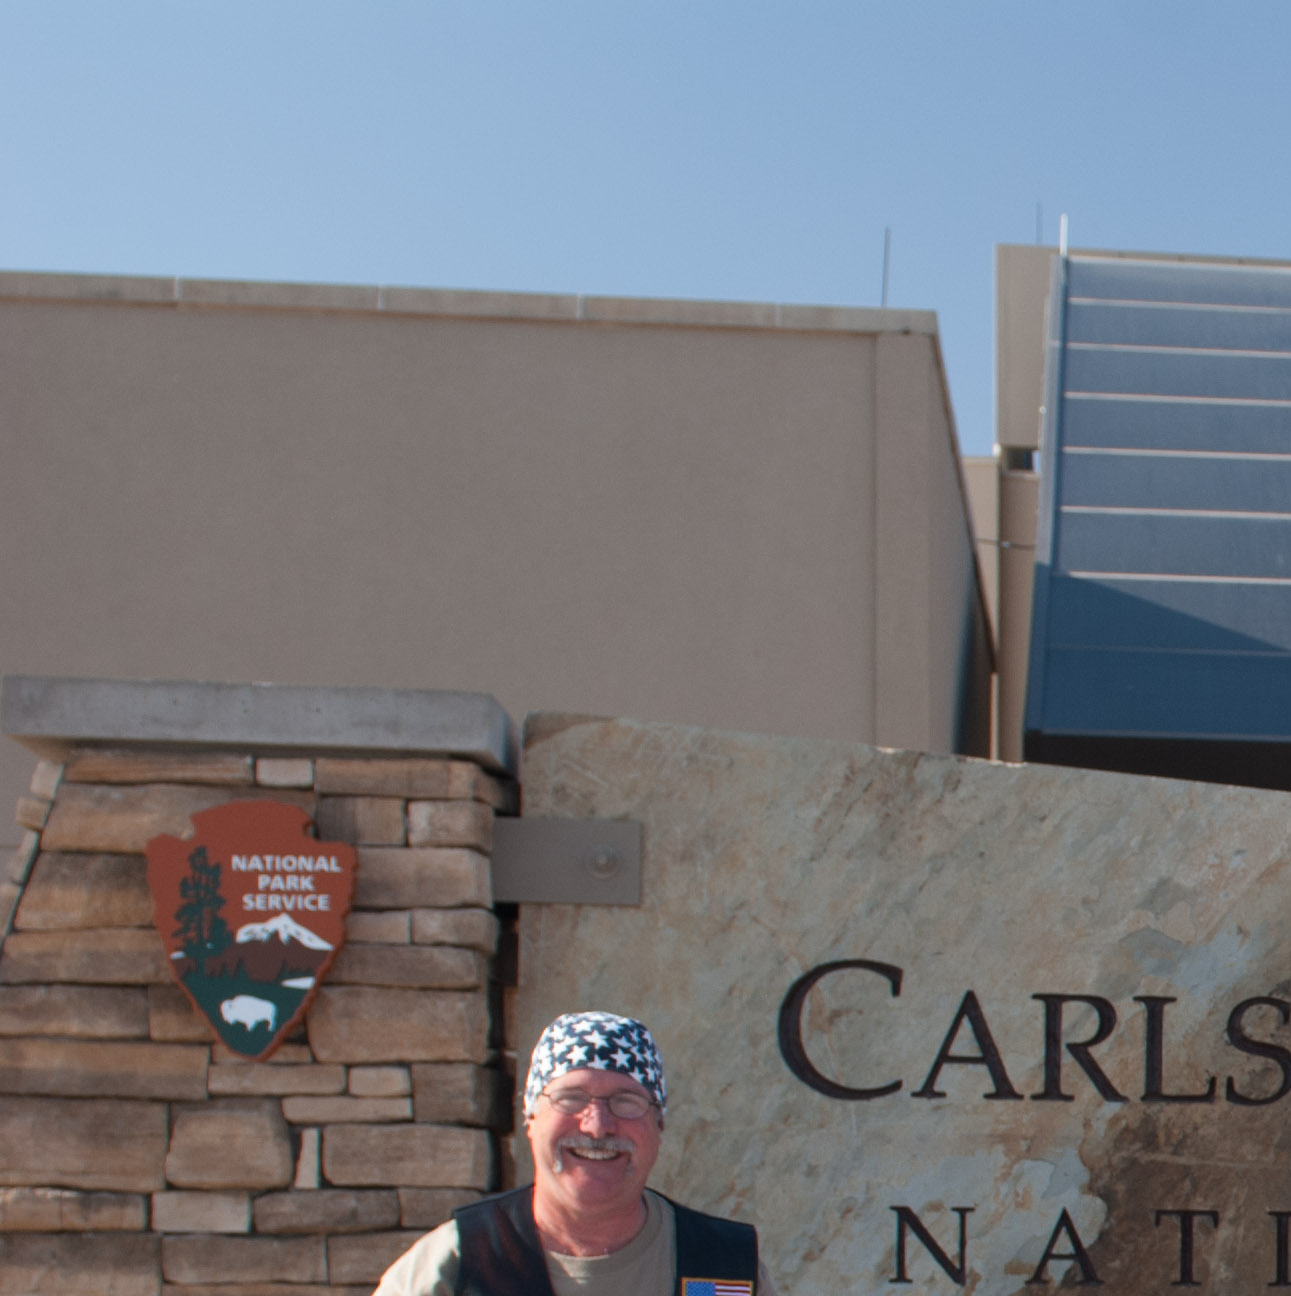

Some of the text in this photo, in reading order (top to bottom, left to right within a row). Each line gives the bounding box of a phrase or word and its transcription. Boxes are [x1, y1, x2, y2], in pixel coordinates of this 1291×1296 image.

[231, 854, 342, 872] NATIONAL
[258, 875, 315, 891] PARK
[242, 894, 330, 912] SERVICE
